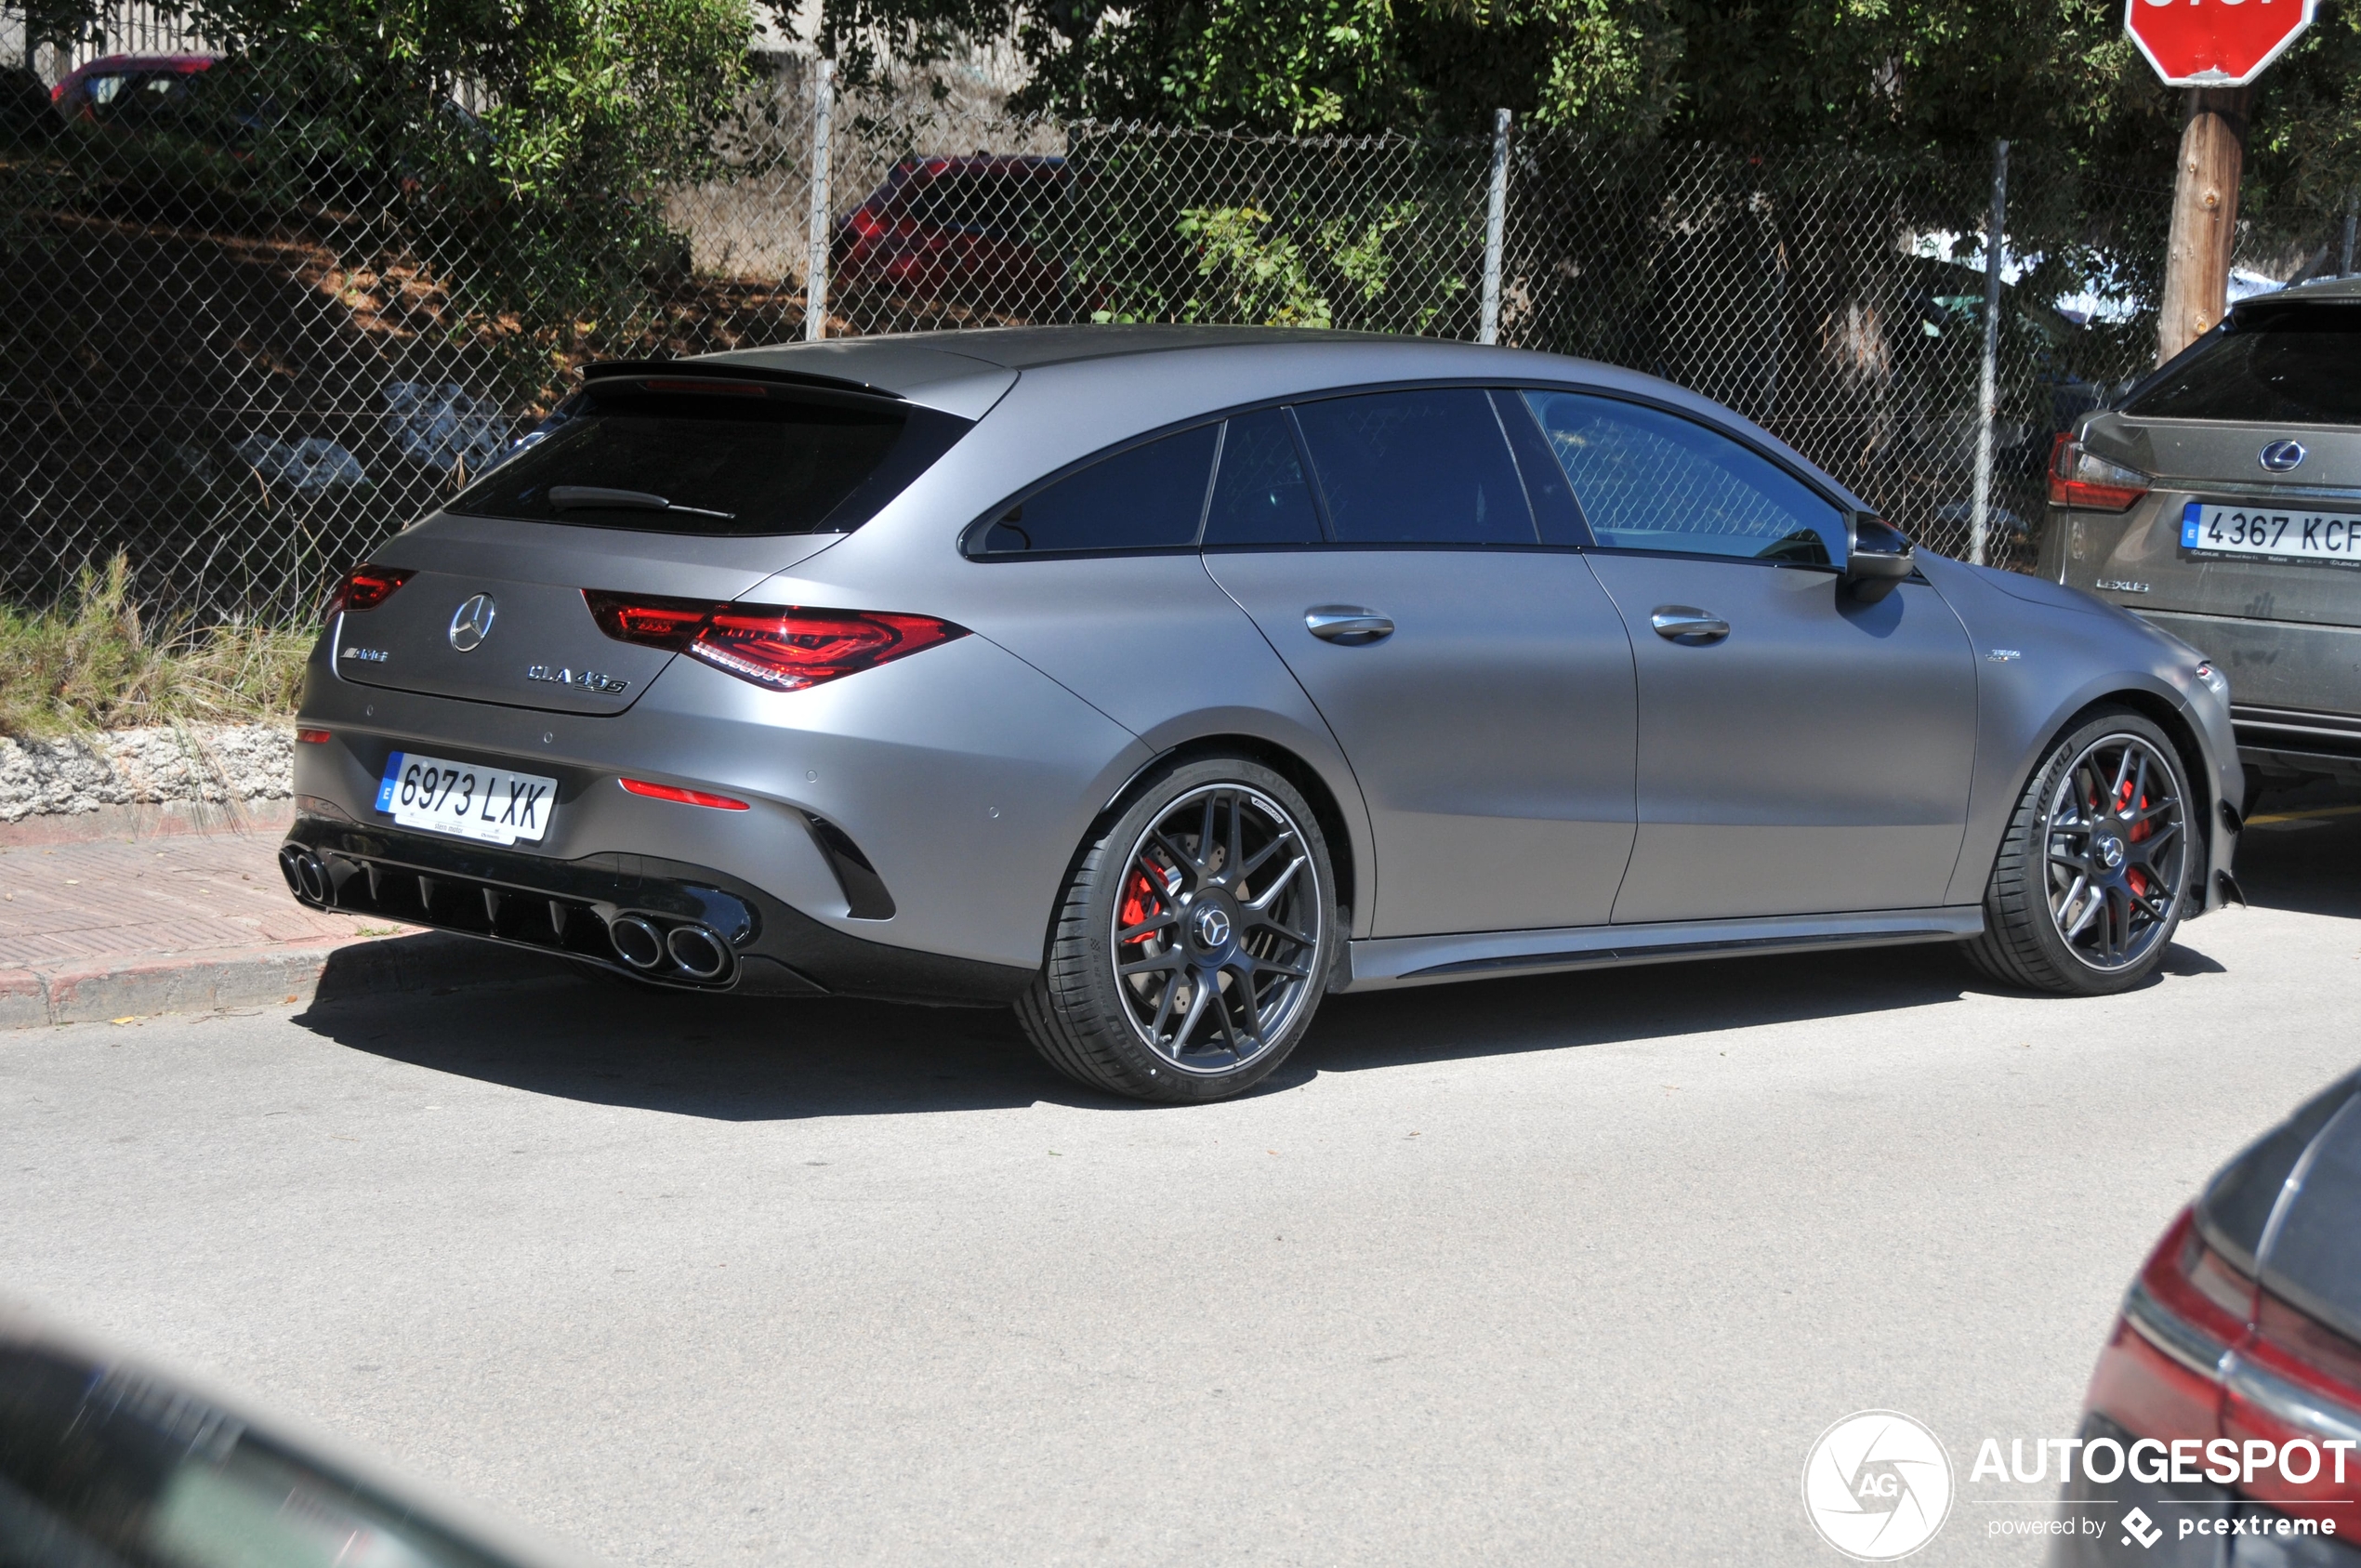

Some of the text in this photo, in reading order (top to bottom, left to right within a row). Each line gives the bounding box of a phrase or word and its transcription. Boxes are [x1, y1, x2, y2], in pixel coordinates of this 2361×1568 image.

[2187, 530, 2195, 538] E
[2208, 512, 2361, 552] 4367 KCF
[2096, 579, 2149, 592] LEXUS
[528, 665, 572, 684] CLA
[383, 787, 391, 799] E
[2034, 745, 2072, 825] MICHELIN
[401, 764, 547, 829] 6973 LXK
[448, 825, 463, 834] motor
